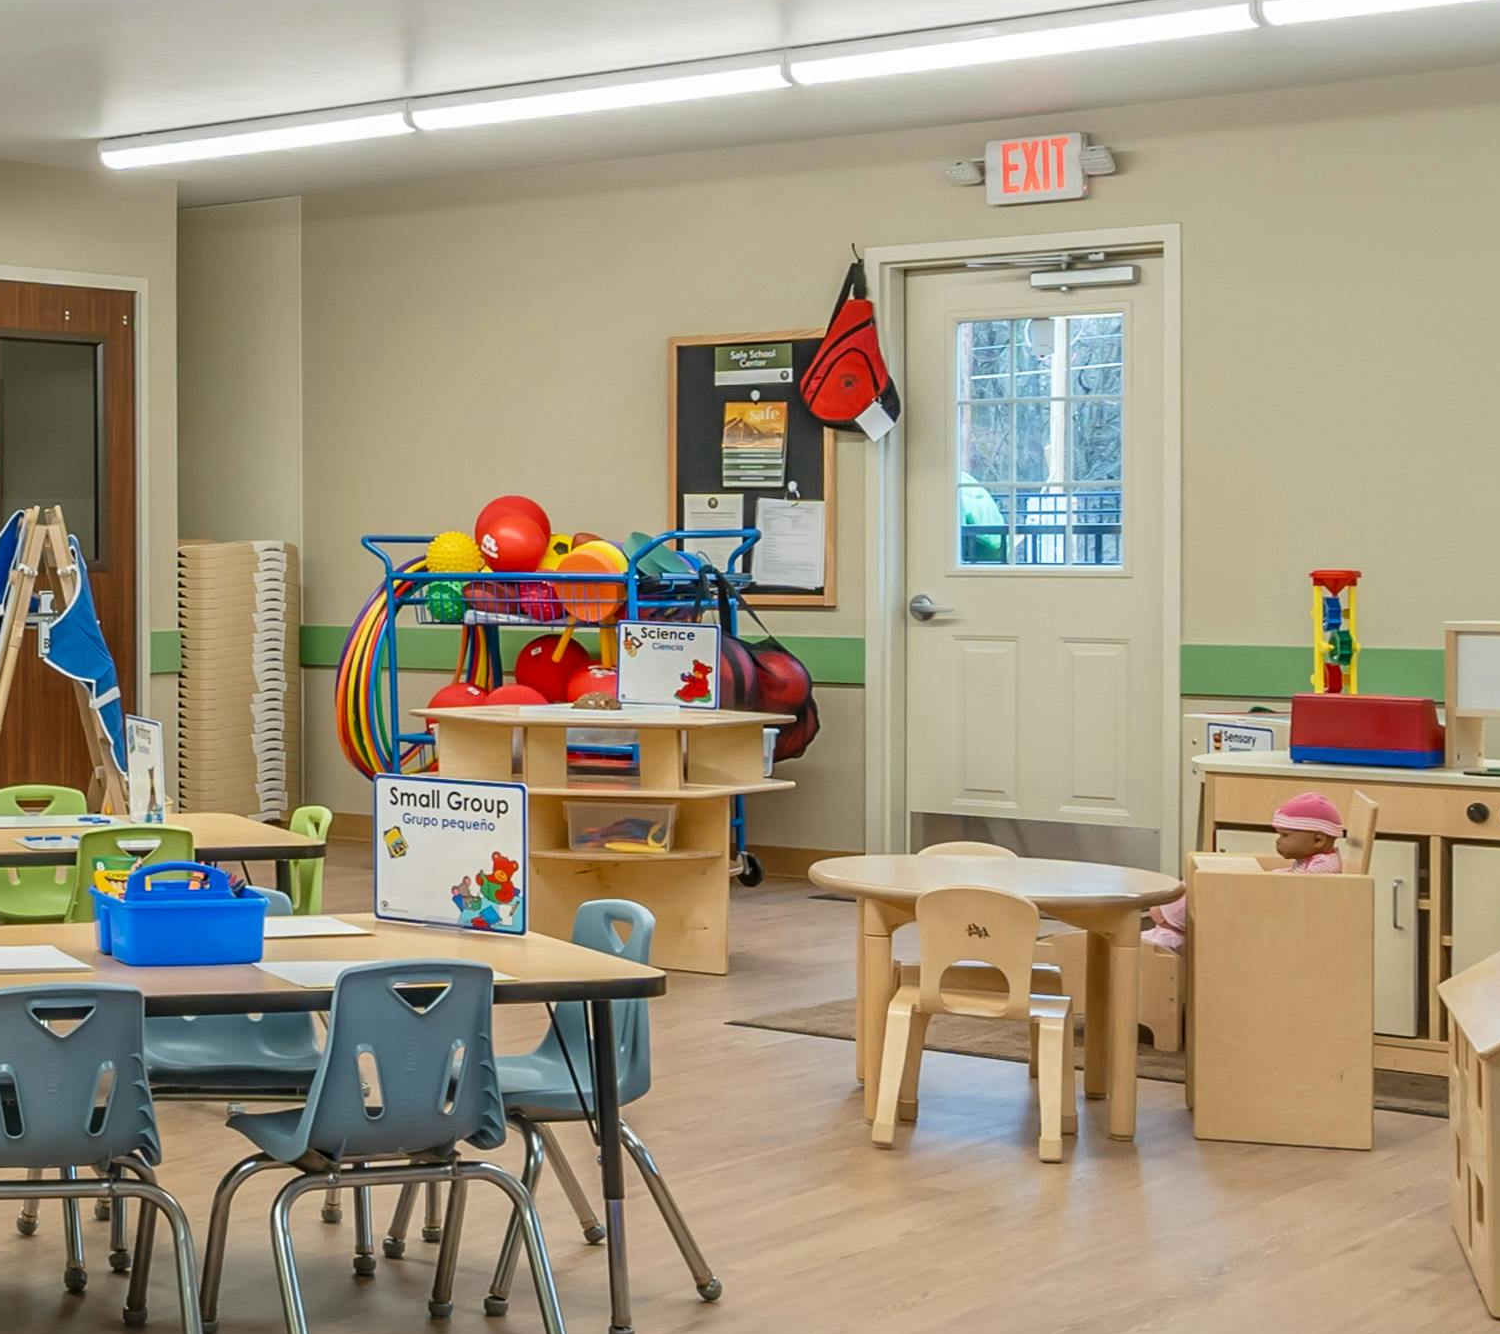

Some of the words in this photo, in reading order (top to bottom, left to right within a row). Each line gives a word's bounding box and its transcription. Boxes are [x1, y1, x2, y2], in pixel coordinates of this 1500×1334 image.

[1001, 136, 1069, 194] EXIT
[730, 349, 748, 360] Safe
[749, 348, 777, 359] School
[739, 358, 767, 368] Center
[749, 405, 781, 420] safe
[640, 627, 695, 641] Science
[651, 642, 684, 651] Ciencia
[1223, 730, 1257, 748] Sensory
[389, 786, 441, 809] Small
[446, 791, 510, 818] Group
[402, 812, 439, 827] Grupo
[441, 818, 496, 832] pequeño
